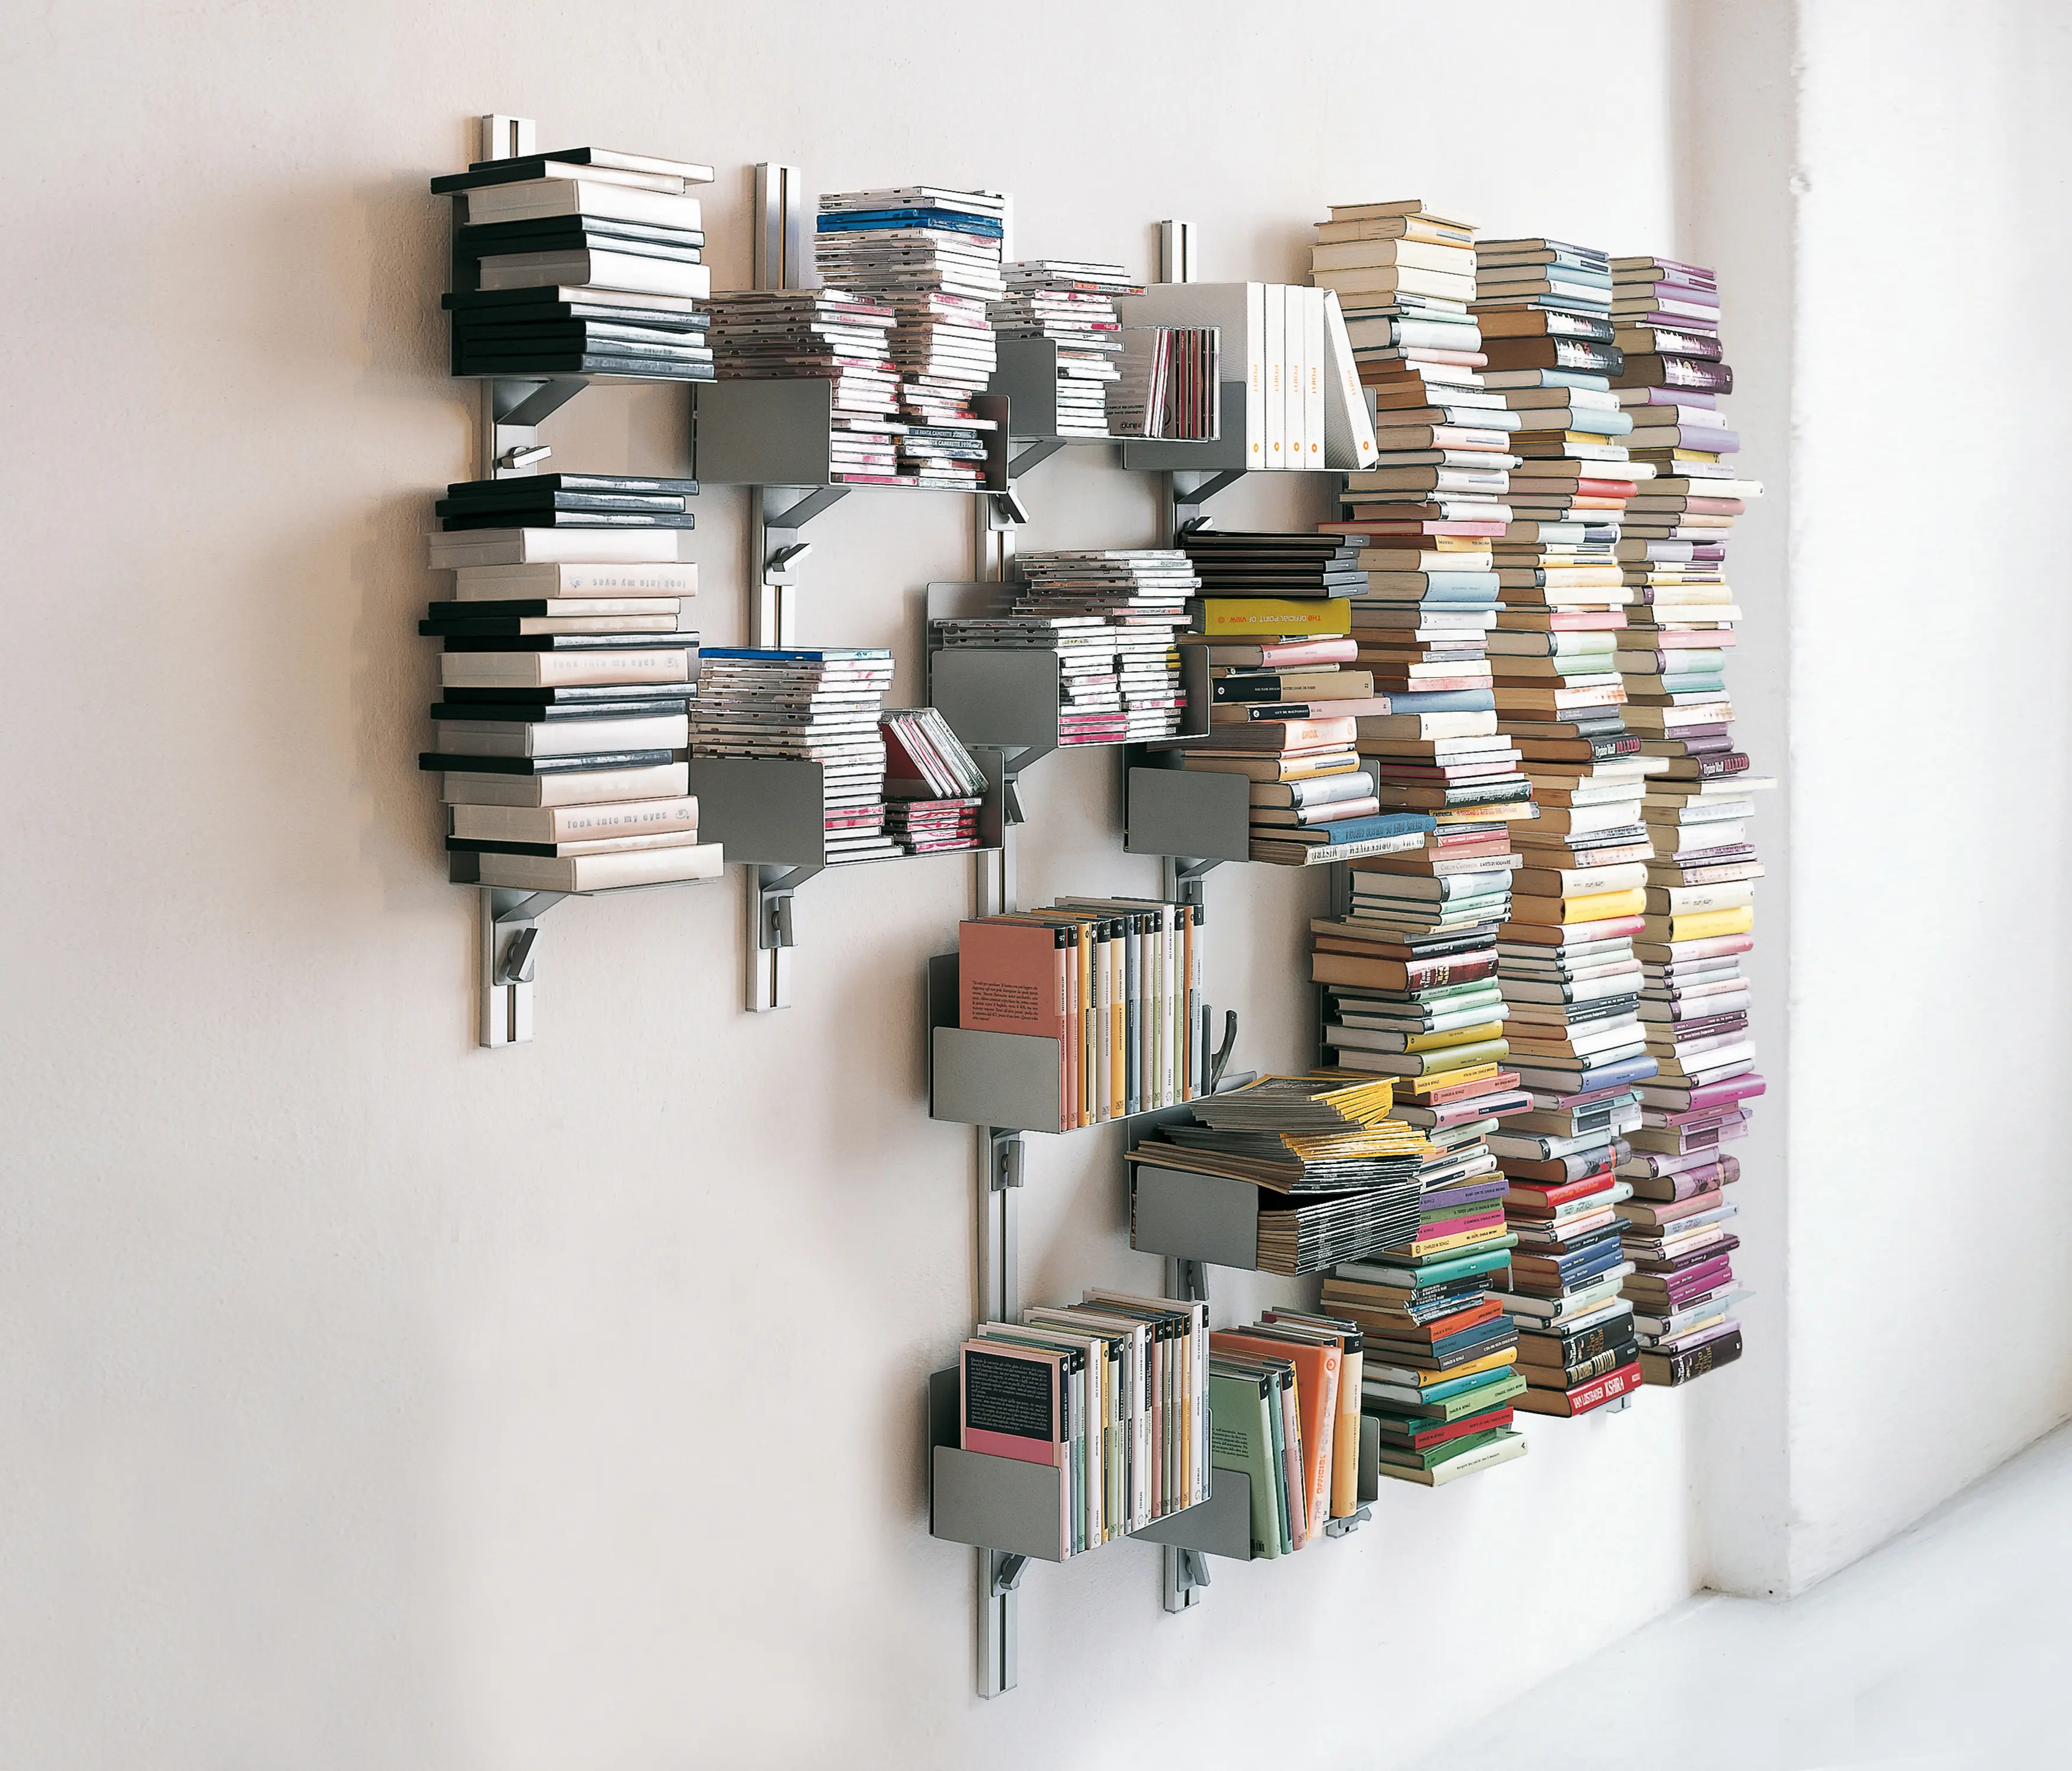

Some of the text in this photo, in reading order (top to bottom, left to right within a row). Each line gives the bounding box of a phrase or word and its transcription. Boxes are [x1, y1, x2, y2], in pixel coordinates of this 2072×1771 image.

[593, 579, 686, 589] look into my eyes
[554, 658, 655, 668] look into my eyes
[568, 811, 667, 829] look into my eyes
[1604, 1375, 1625, 1397] KSHIRA
